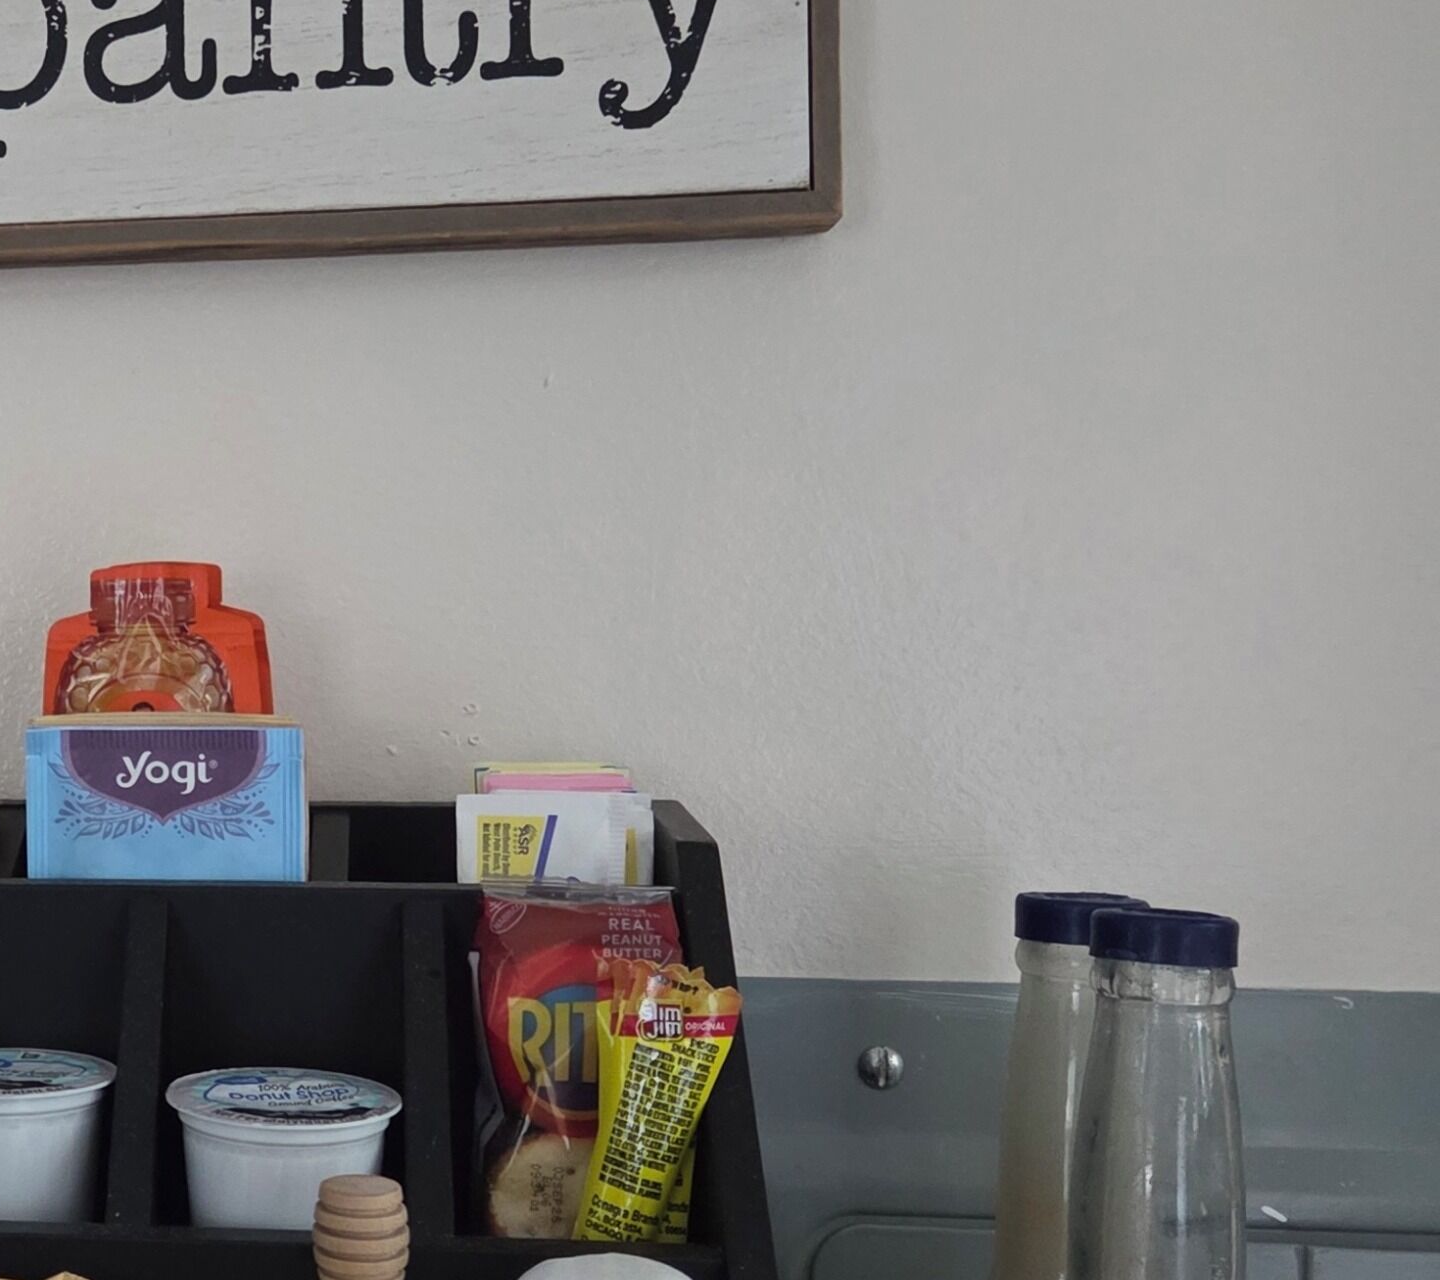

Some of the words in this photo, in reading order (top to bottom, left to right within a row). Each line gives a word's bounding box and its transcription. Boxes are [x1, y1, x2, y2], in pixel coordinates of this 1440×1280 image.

[608, 918, 655, 930] REAL
[601, 934, 662, 945] PEANUT
[602, 948, 661, 958] BUTTER
[685, 1021, 726, 1032] ORIGINAL
[507, 997, 598, 1087] RIT
[229, 1091, 291, 1101] Donut
[296, 1087, 349, 1101] Shop
